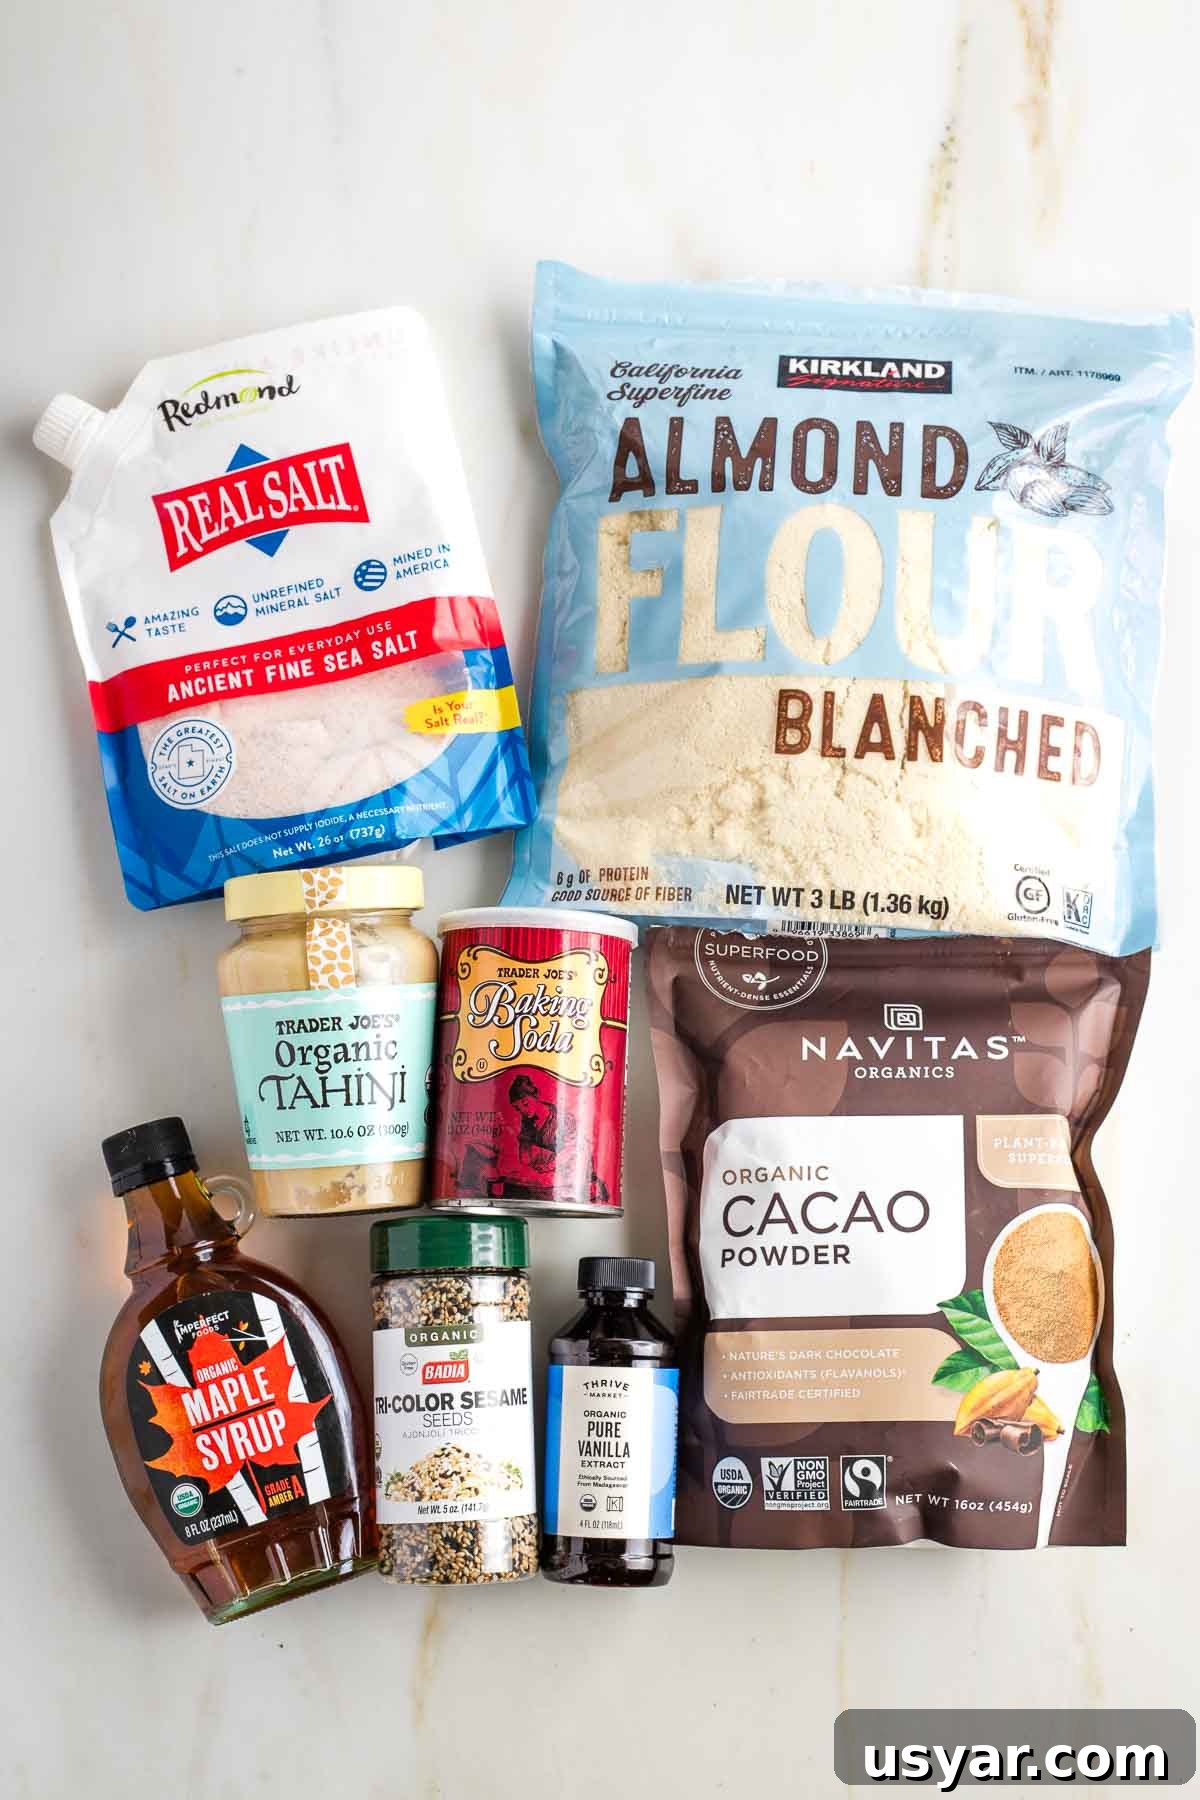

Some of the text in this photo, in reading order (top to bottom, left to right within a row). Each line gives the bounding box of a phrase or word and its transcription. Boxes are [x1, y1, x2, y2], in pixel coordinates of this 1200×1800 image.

[609, 359, 743, 383] California
[788, 357, 946, 379] KIRKLAND
[787, 375, 946, 391] Signature
[157, 374, 302, 433] Redmond
[606, 382, 733, 408] Superfine
[608, 416, 969, 503] ALMOND
[163, 480, 265, 560] REAL
[393, 543, 450, 567] MINED IN
[396, 558, 450, 580] AMERICA
[251, 577, 324, 603] UNREFINED
[595, 502, 1104, 694] FLOUR
[255, 587, 341, 617] MINERAL SALT
[144, 606, 200, 626] AMAZING
[146, 622, 187, 639] TASTE
[184, 620, 393, 674] PERFECT FOR EVERYDAY USE
[167, 629, 418, 704] ANCIENT FINE SEA SALT
[433, 704, 443, 715] Is
[424, 716, 450, 729] Salt
[159, 726, 224, 757] THE GREATEST
[773, 687, 1101, 786] BLANCHED
[158, 765, 225, 800] SALT ON EARTH
[208, 852, 224, 863] THIS
[224, 844, 241, 858] SALT
[241, 837, 264, 852] DOES
[264, 831, 283, 842] NOT
[283, 822, 314, 839] SUPPLY
[348, 813, 355, 822] A
[356, 805, 405, 820] NECESSARY
[272, 846, 294, 859] Net
[295, 840, 316, 854] Wt.
[317, 836, 332, 847] 26
[349, 823, 386, 840] (737g)
[556, 866, 650, 888] 6 g OF PROTEIN
[551, 886, 693, 902] GOOD SOURCE OF FIBER
[725, 884, 950, 920] NET WT 3 LB (1.36 kg)
[1023, 887, 1043, 901] GF
[704, 943, 820, 962] SUPERFOOD
[497, 967, 540, 979] TRADER
[773, 965, 815, 1000] ESSENTIALS
[467, 980, 593, 1030] Baking
[275, 1016, 343, 1036] TRADER
[488, 1014, 574, 1060] Soda
[275, 1034, 399, 1074] Organic
[854, 1066, 955, 1079] ORGANICS
[258, 1064, 408, 1111] TAHINI
[275, 1129, 300, 1144] NET
[303, 1127, 327, 1141] WT.
[330, 1125, 354, 1140] 10.6
[357, 1124, 376, 1137] OZ
[722, 1165, 830, 1185] ORGANIC
[722, 1190, 930, 1237] CACAO
[721, 1244, 851, 1268] POWDER
[173, 1310, 230, 1344] IMPERFECT
[191, 1324, 220, 1339] FOODS
[409, 1329, 479, 1343] ORGANIC
[729, 1348, 902, 1361] NATURE'S DARK CHOCOLATE
[196, 1357, 239, 1383] ORGANIC
[424, 1363, 466, 1380] BADIA
[731, 1369, 817, 1381] ANTIOXIDANTS
[583, 1379, 631, 1391] THRIVE
[731, 1388, 861, 1401] FAIRTRADE CERTIFIED
[181, 1366, 275, 1427] MAPLE
[460, 1387, 528, 1410] SESAME
[423, 1411, 473, 1428] SEEDS
[583, 1410, 627, 1418] ORGANIC
[195, 1408, 286, 1471] SYRUP
[587, 1421, 622, 1438] PURE
[578, 1440, 631, 1458] VANILLA
[581, 1460, 626, 1469] EXTRACT
[720, 1468, 744, 1481] USDA
[796, 1460, 825, 1470] NON
[796, 1470, 826, 1480] GMO
[796, 1480, 825, 1490] Project
[177, 1490, 194, 1502] USDA
[264, 1475, 305, 1499] GRADE A
[717, 1484, 748, 1495] ORGANIC
[768, 1491, 826, 1500] VERIFIED
[268, 1491, 294, 1508] AMBER
[417, 1505, 429, 1515] Net
[442, 1504, 448, 1514] 5
[765, 1501, 829, 1509] nongmoproject.org
[844, 1497, 884, 1507] FAIRTRADE
[895, 1493, 1033, 1514] NET WT 16oz (454g)
[184, 1526, 192, 1538] 8
[199, 1519, 211, 1533] OZ
[210, 1510, 239, 1532] (237mL)
[584, 1520, 591, 1528] FL
[592, 1520, 600, 1528] OZ
